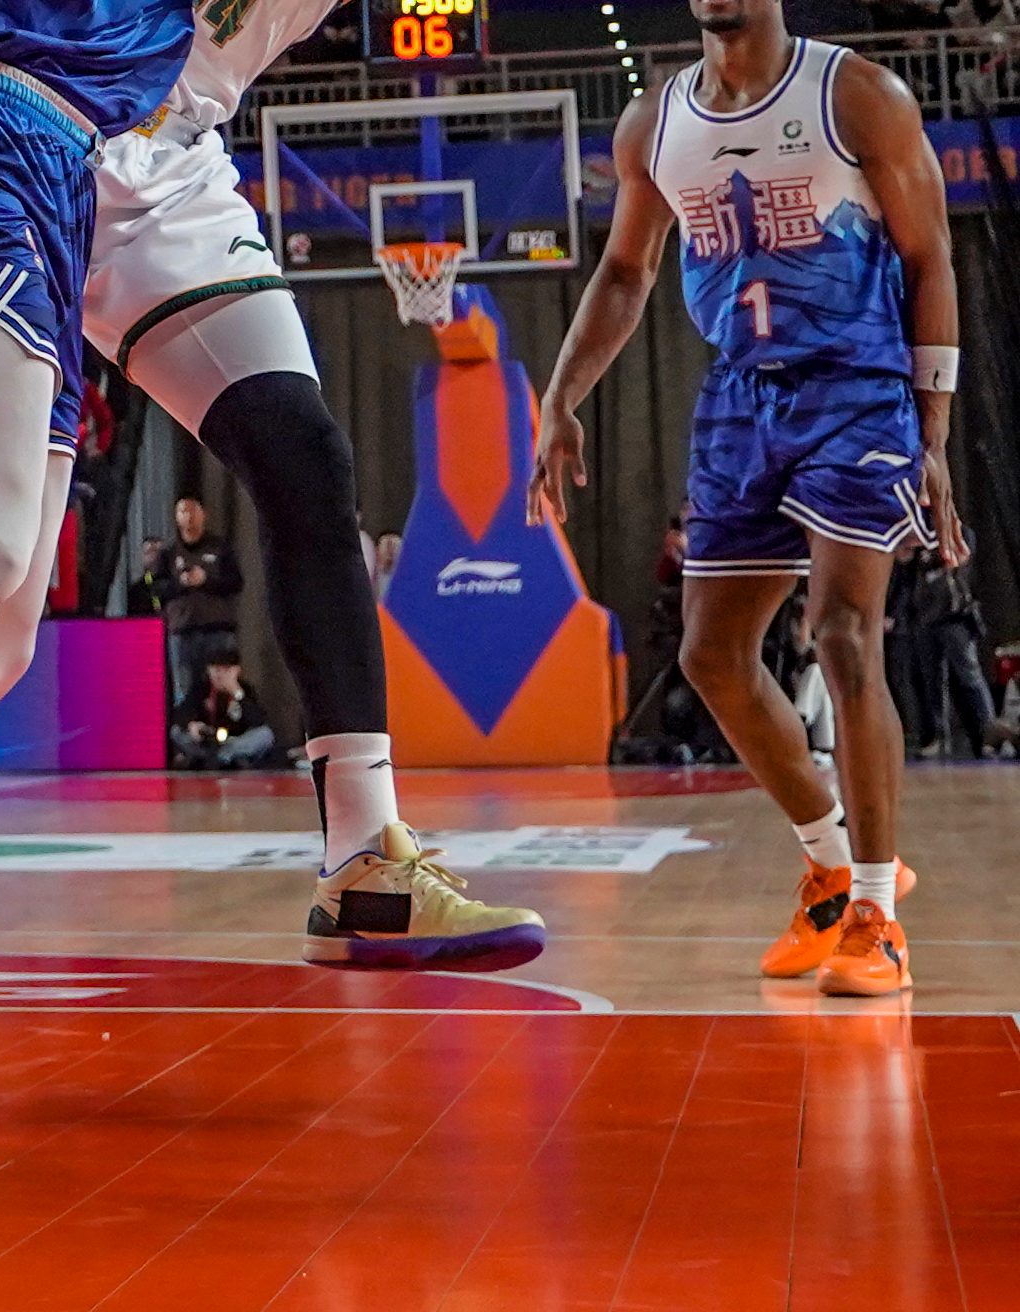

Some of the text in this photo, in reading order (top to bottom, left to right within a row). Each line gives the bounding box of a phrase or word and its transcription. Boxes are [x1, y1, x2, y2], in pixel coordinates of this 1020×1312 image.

[392, 15, 453, 60] 06
[678, 175, 827, 259] 新疆
[737, 279, 772, 339] 1
